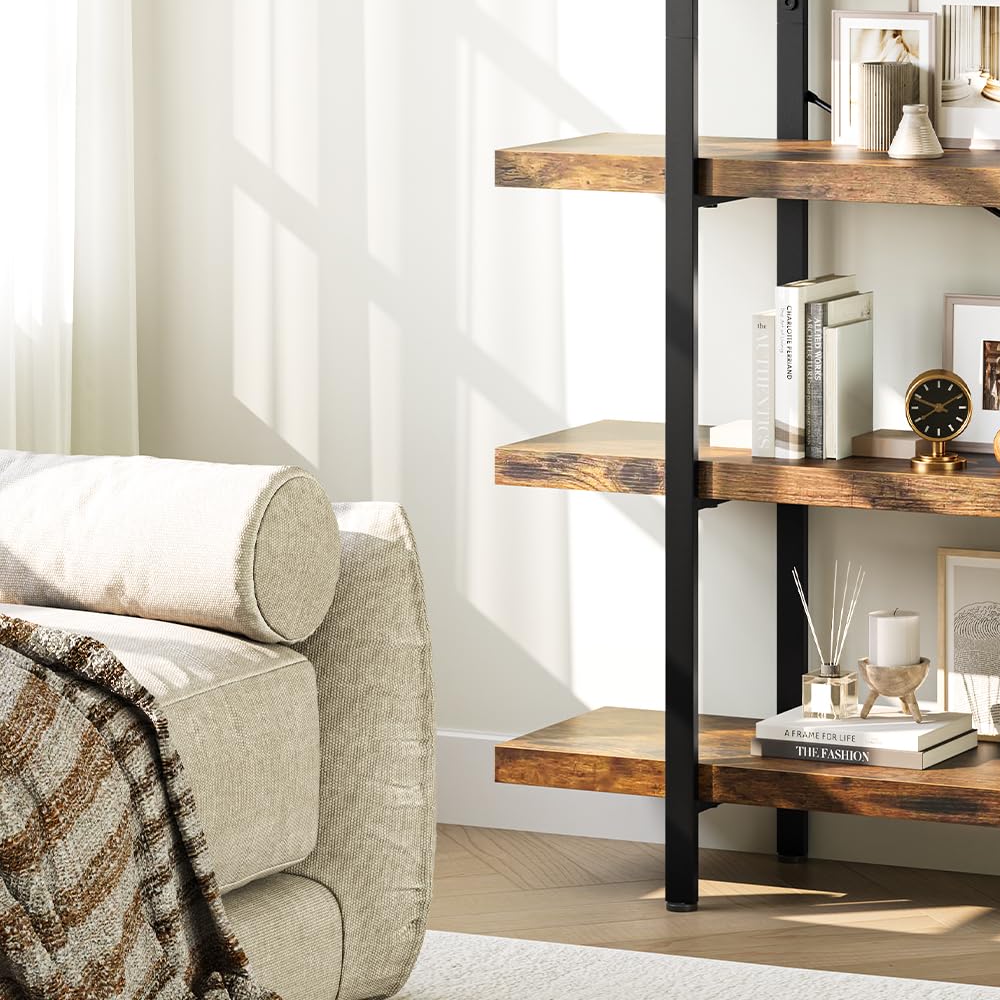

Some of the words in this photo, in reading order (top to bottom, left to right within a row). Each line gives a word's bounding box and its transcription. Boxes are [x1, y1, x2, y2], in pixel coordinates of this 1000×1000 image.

[792, 730, 820, 740] FRAME
[822, 732, 838, 741] FOR
[839, 734, 856, 742] LIFE
[796, 746, 820, 758] THE
[822, 748, 870, 762] FASHION
